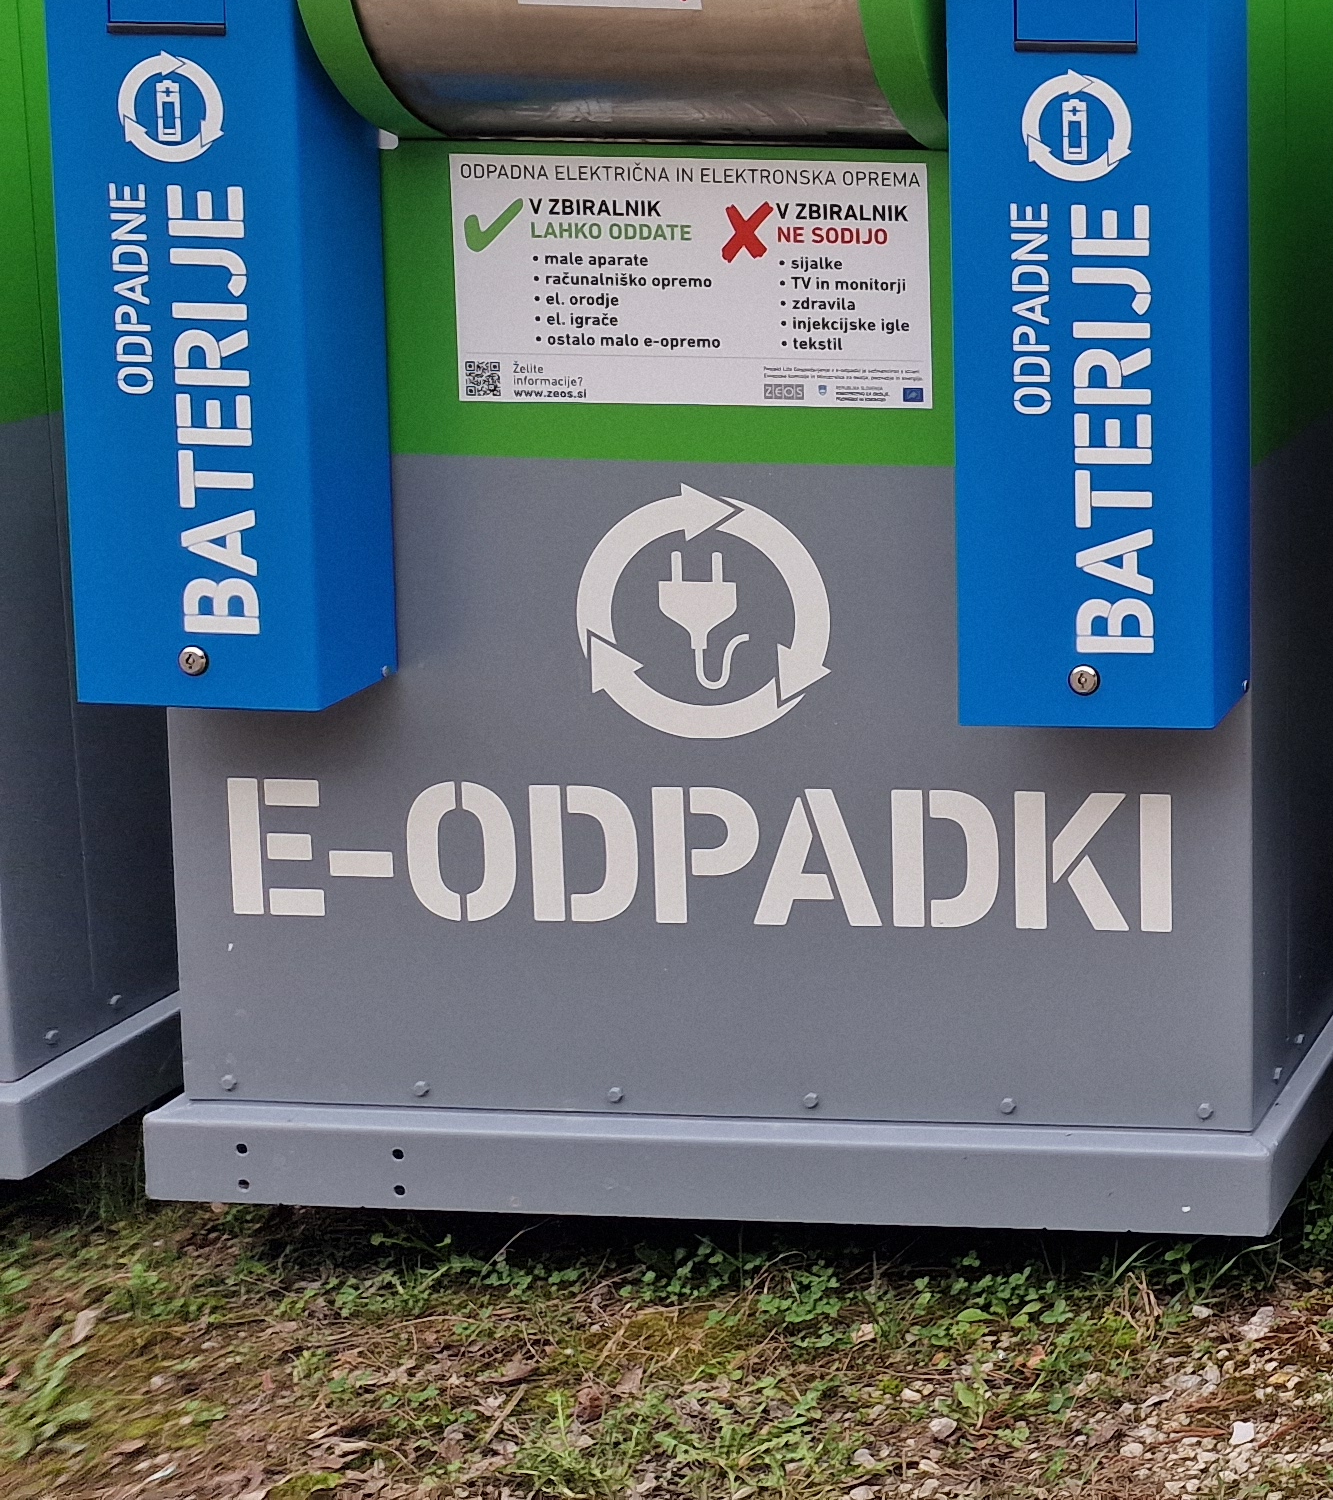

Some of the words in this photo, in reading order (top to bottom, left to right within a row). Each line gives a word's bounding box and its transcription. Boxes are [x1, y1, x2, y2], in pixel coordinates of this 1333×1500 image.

[460, 163, 549, 180] ODPADNA
[554, 162, 670, 183] ELEKTRIČNA
[676, 167, 694, 183] IN
[700, 167, 837, 186] ELEKTRONSKA
[842, 170, 921, 188] OPREMA
[528, 197, 543, 215] V
[548, 198, 662, 217] ZBIRALNIK
[775, 202, 790, 220] V
[795, 202, 909, 222] ZBIRALNIK
[530, 221, 602, 240] LAHKO
[608, 222, 692, 242] ODDATE
[777, 226, 805, 244] NE
[811, 226, 888, 245] SODIJO
[544, 251, 584, 266] male
[588, 253, 649, 269] aparate
[791, 256, 843, 273] sijalke
[108, 182, 154, 395] ODPADNE
[545, 271, 647, 287] računalniško
[651, 277, 712, 290] opremo
[790, 276, 812, 290] TV
[815, 276, 830, 291] in
[834, 277, 906, 295] monitorji
[545, 291, 565, 306] el.
[569, 292, 619, 309] orodje
[791, 296, 856, 311] zdravila
[1009, 202, 1052, 415] ODPADNE
[546, 311, 566, 326] el.
[570, 312, 619, 329] igrače
[792, 316, 876, 334] injekcijske
[880, 318, 910, 335] igle
[547, 332, 596, 346] ostalo
[600, 333, 639, 347] malo
[643, 337, 721, 351] e-opremo
[792, 336, 843, 351] tekstil
[512, 360, 544, 374] Želite
[513, 375, 583, 389] informacije?
[513, 388, 587, 399] www.zeos.si
[166, 184, 261, 635] BATERIJE
[1070, 204, 1155, 654] BATERIJE
[226, 777, 1173, 933] E-ODPADKI
